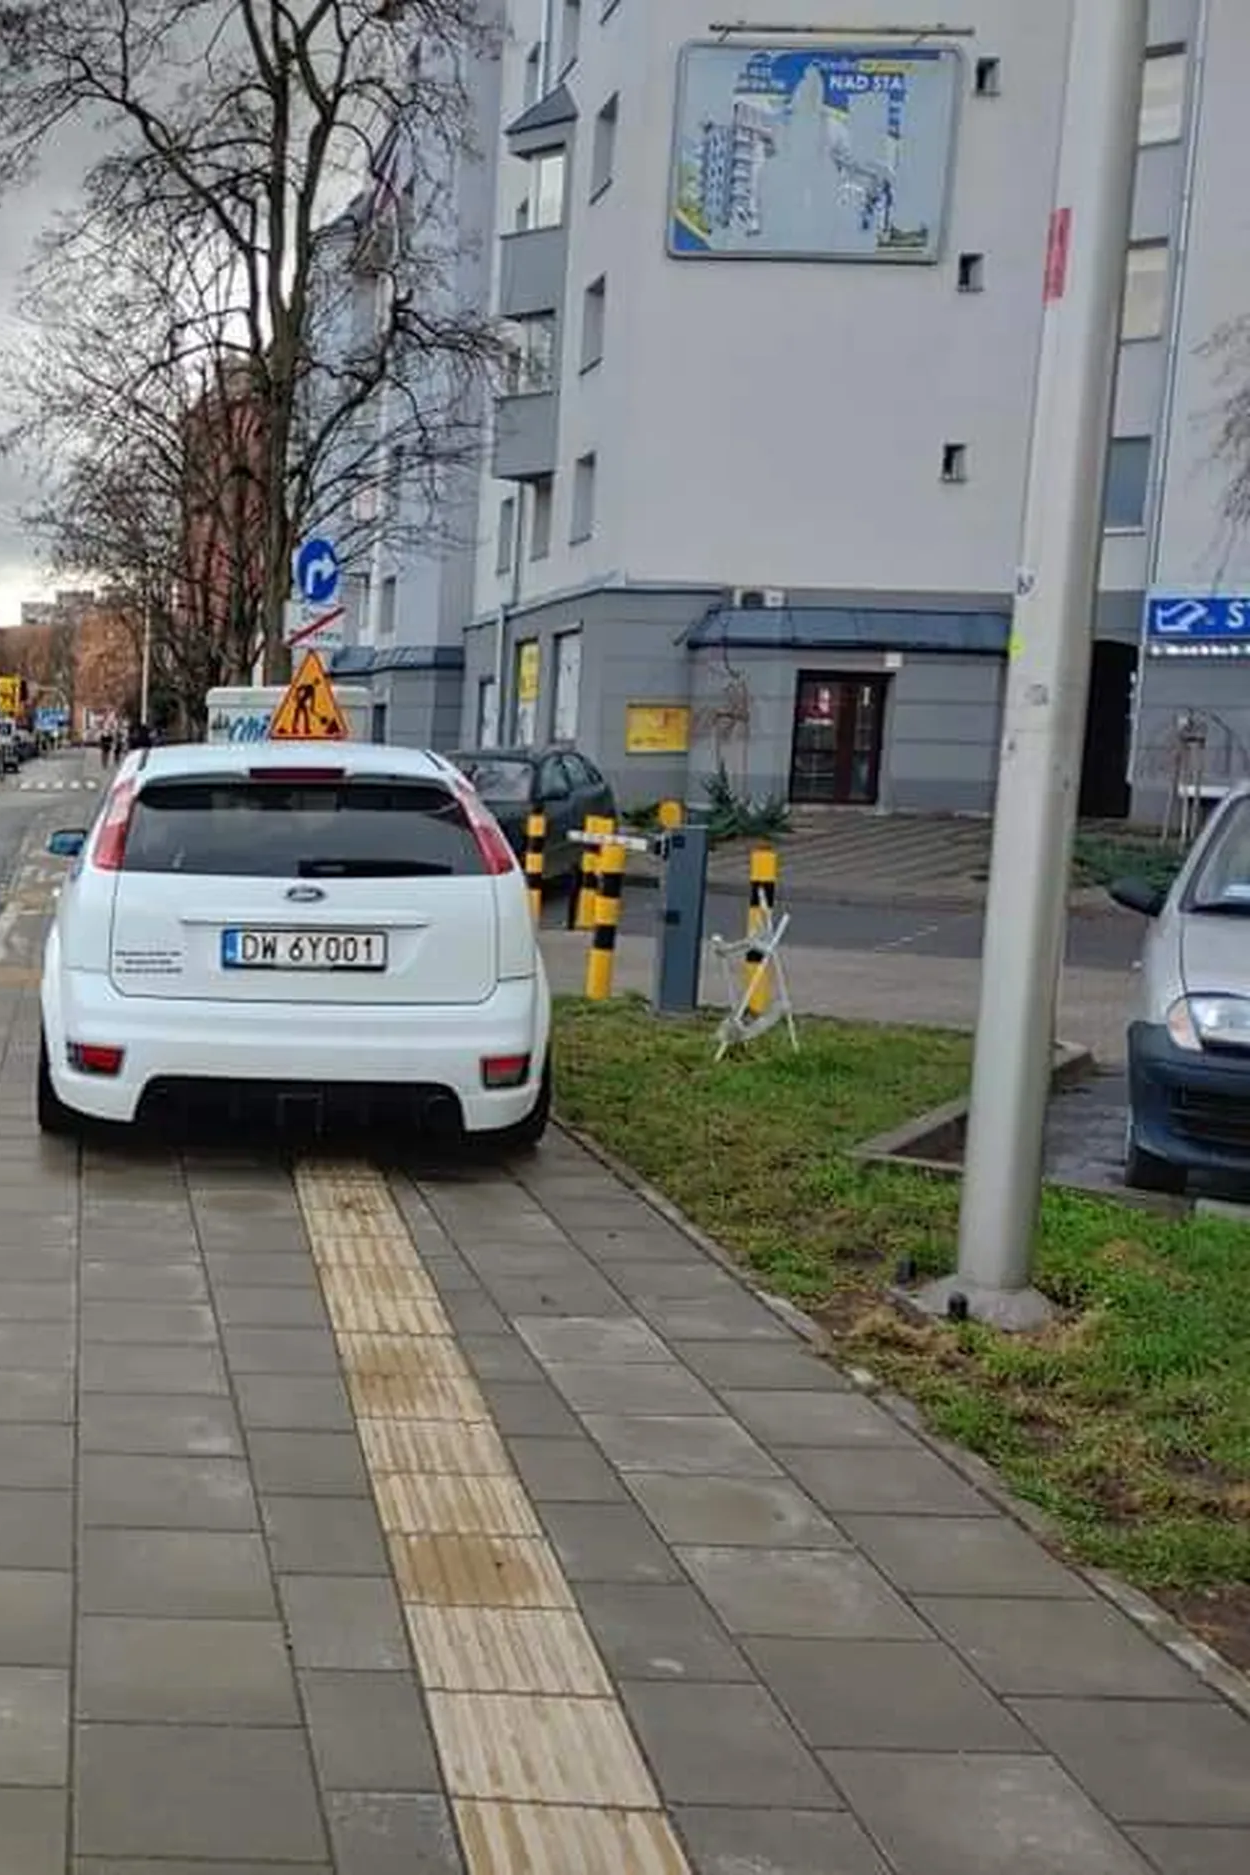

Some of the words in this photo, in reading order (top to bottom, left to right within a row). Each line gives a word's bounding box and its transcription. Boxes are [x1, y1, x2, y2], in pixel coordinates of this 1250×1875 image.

[829, 74, 869, 91] NAD
[241, 934, 277, 960] DW
[288, 936, 374, 962] 6Y001
